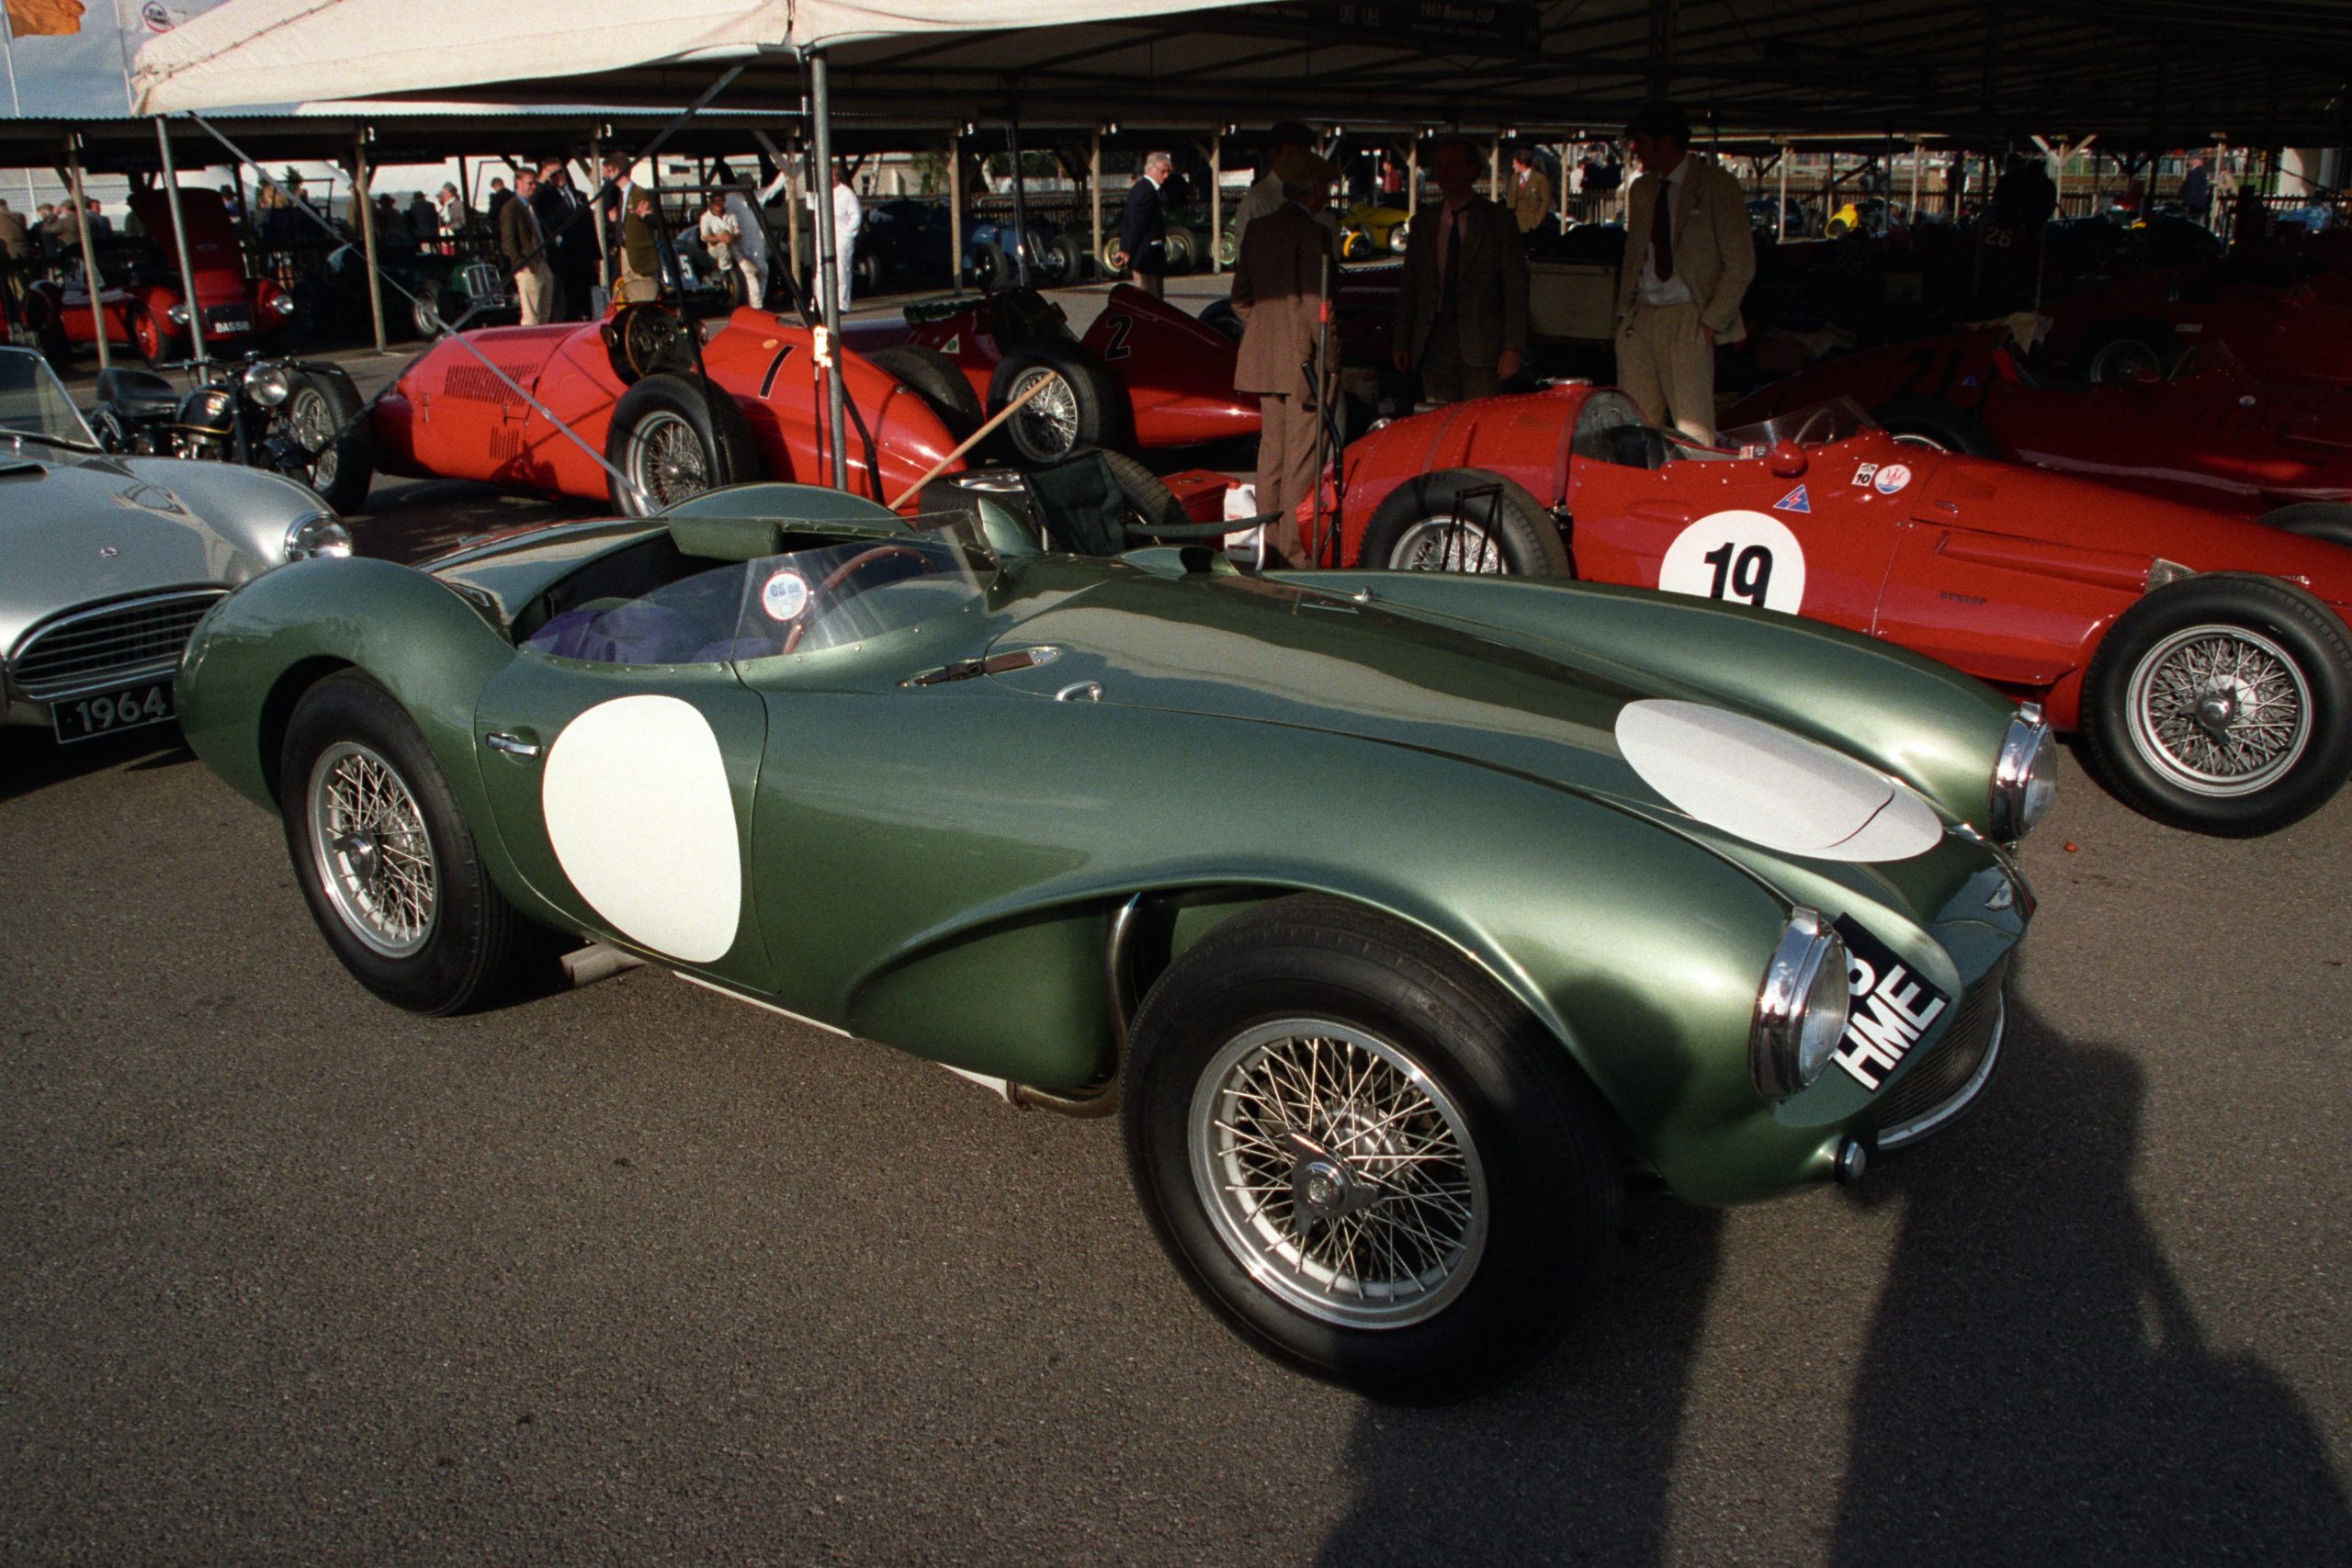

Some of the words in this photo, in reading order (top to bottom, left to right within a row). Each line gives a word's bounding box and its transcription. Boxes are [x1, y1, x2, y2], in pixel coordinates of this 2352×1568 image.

[368, 125, 376, 142] 2
[1984, 226, 2013, 248] 26
[1105, 314, 1132, 360] 2
[758, 344, 797, 400] 1
[1703, 541, 1773, 607] 19
[74, 685, 166, 733] 1964
[1826, 963, 1947, 1091] HME
